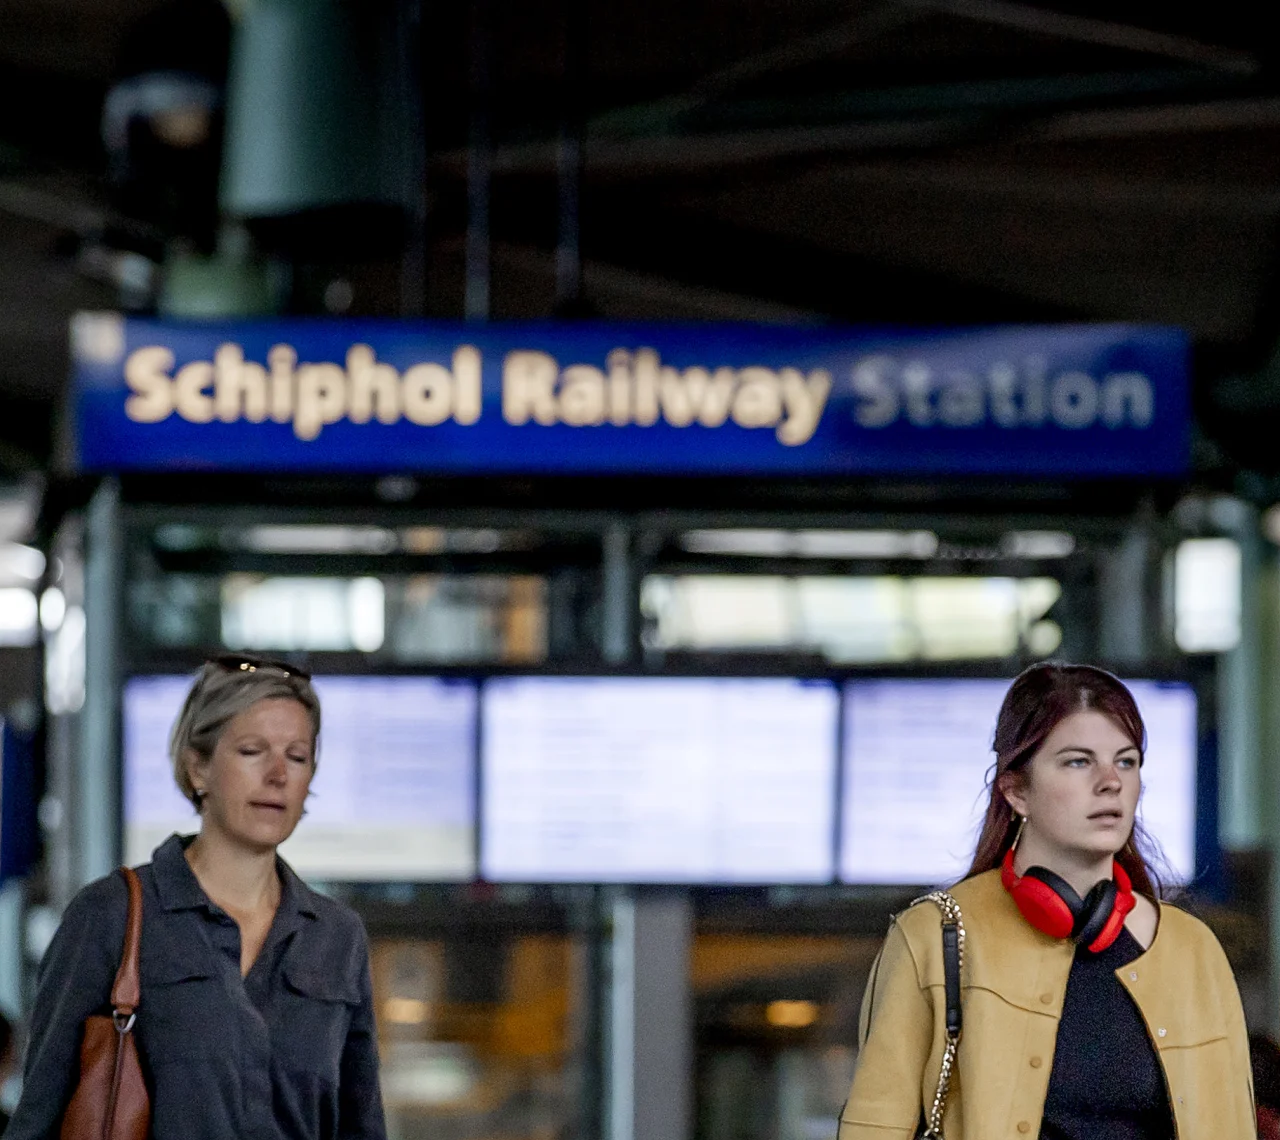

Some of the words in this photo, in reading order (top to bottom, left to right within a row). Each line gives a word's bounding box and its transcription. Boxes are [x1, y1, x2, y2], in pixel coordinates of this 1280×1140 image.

[123, 342, 483, 442] Schiphol
[502, 346, 833, 447] Railway
[850, 352, 1157, 430] Station
